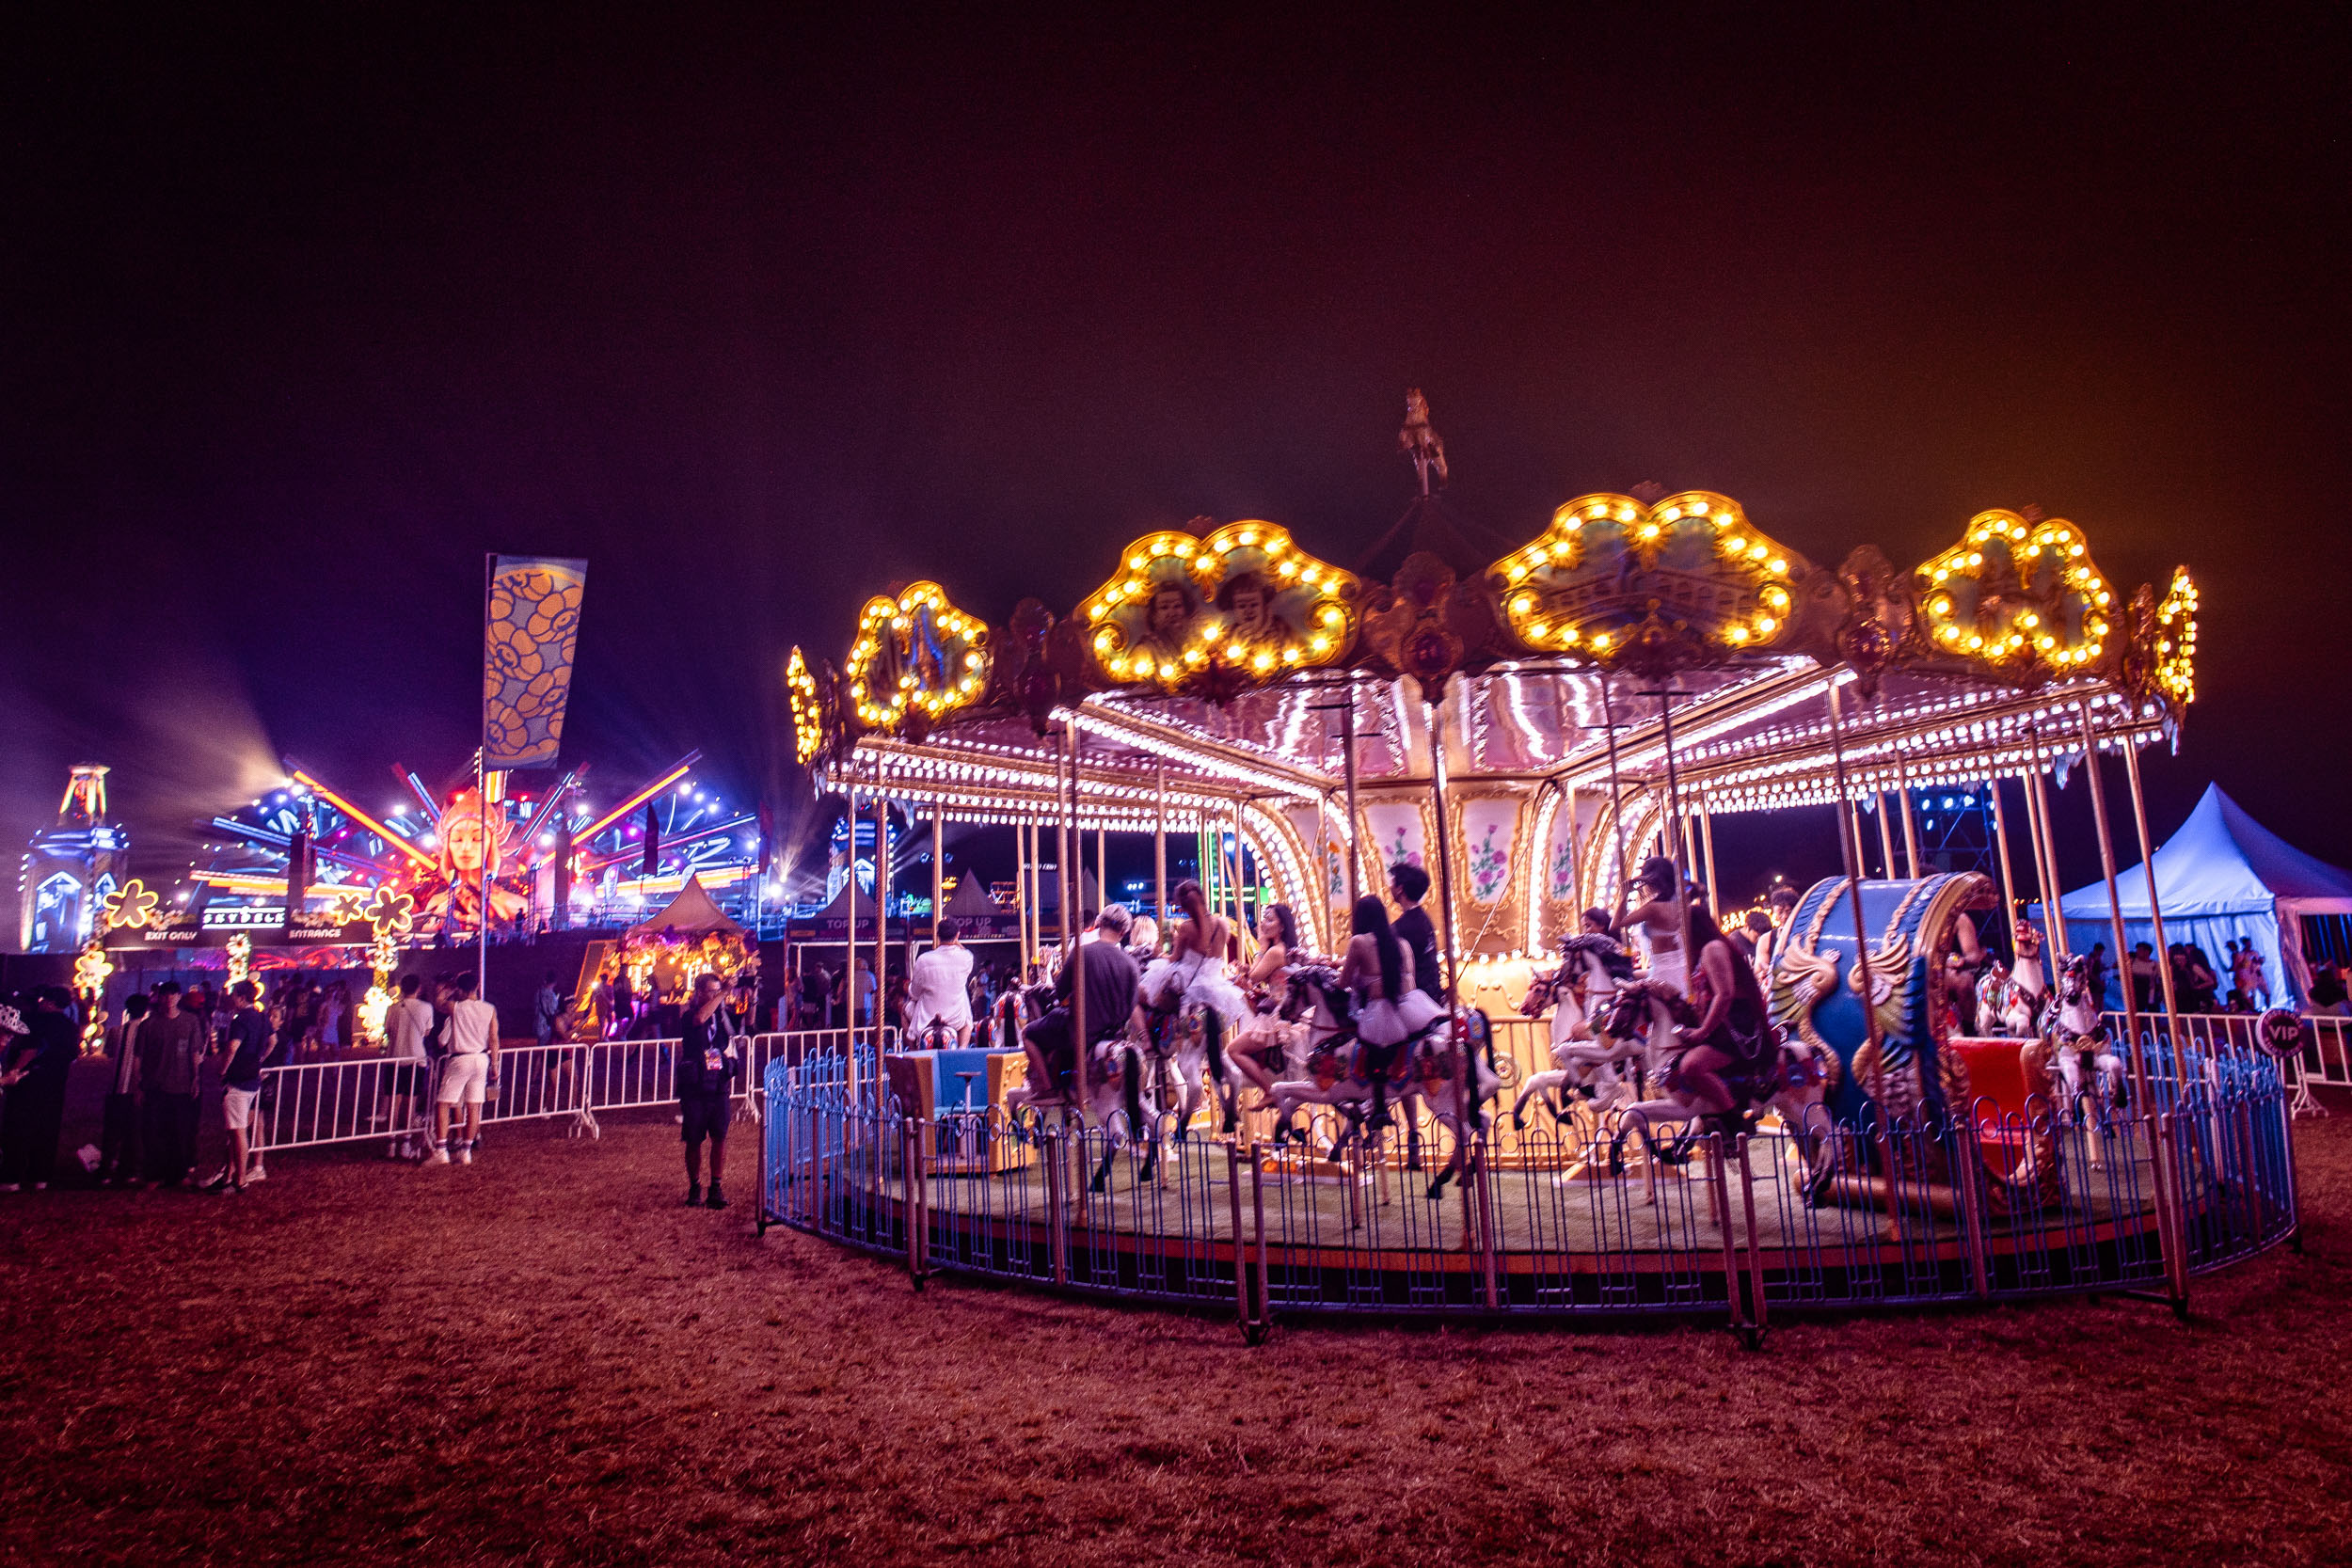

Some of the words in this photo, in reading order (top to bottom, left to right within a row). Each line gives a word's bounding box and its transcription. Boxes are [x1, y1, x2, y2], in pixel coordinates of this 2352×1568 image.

[203, 913, 285, 924] SKYDECK
[951, 917, 973, 927] OP
[976, 917, 992, 927] UP
[145, 930, 167, 941] EXIT
[289, 928, 342, 939] ENTRANCE
[2268, 1025, 2298, 1040] VIP
